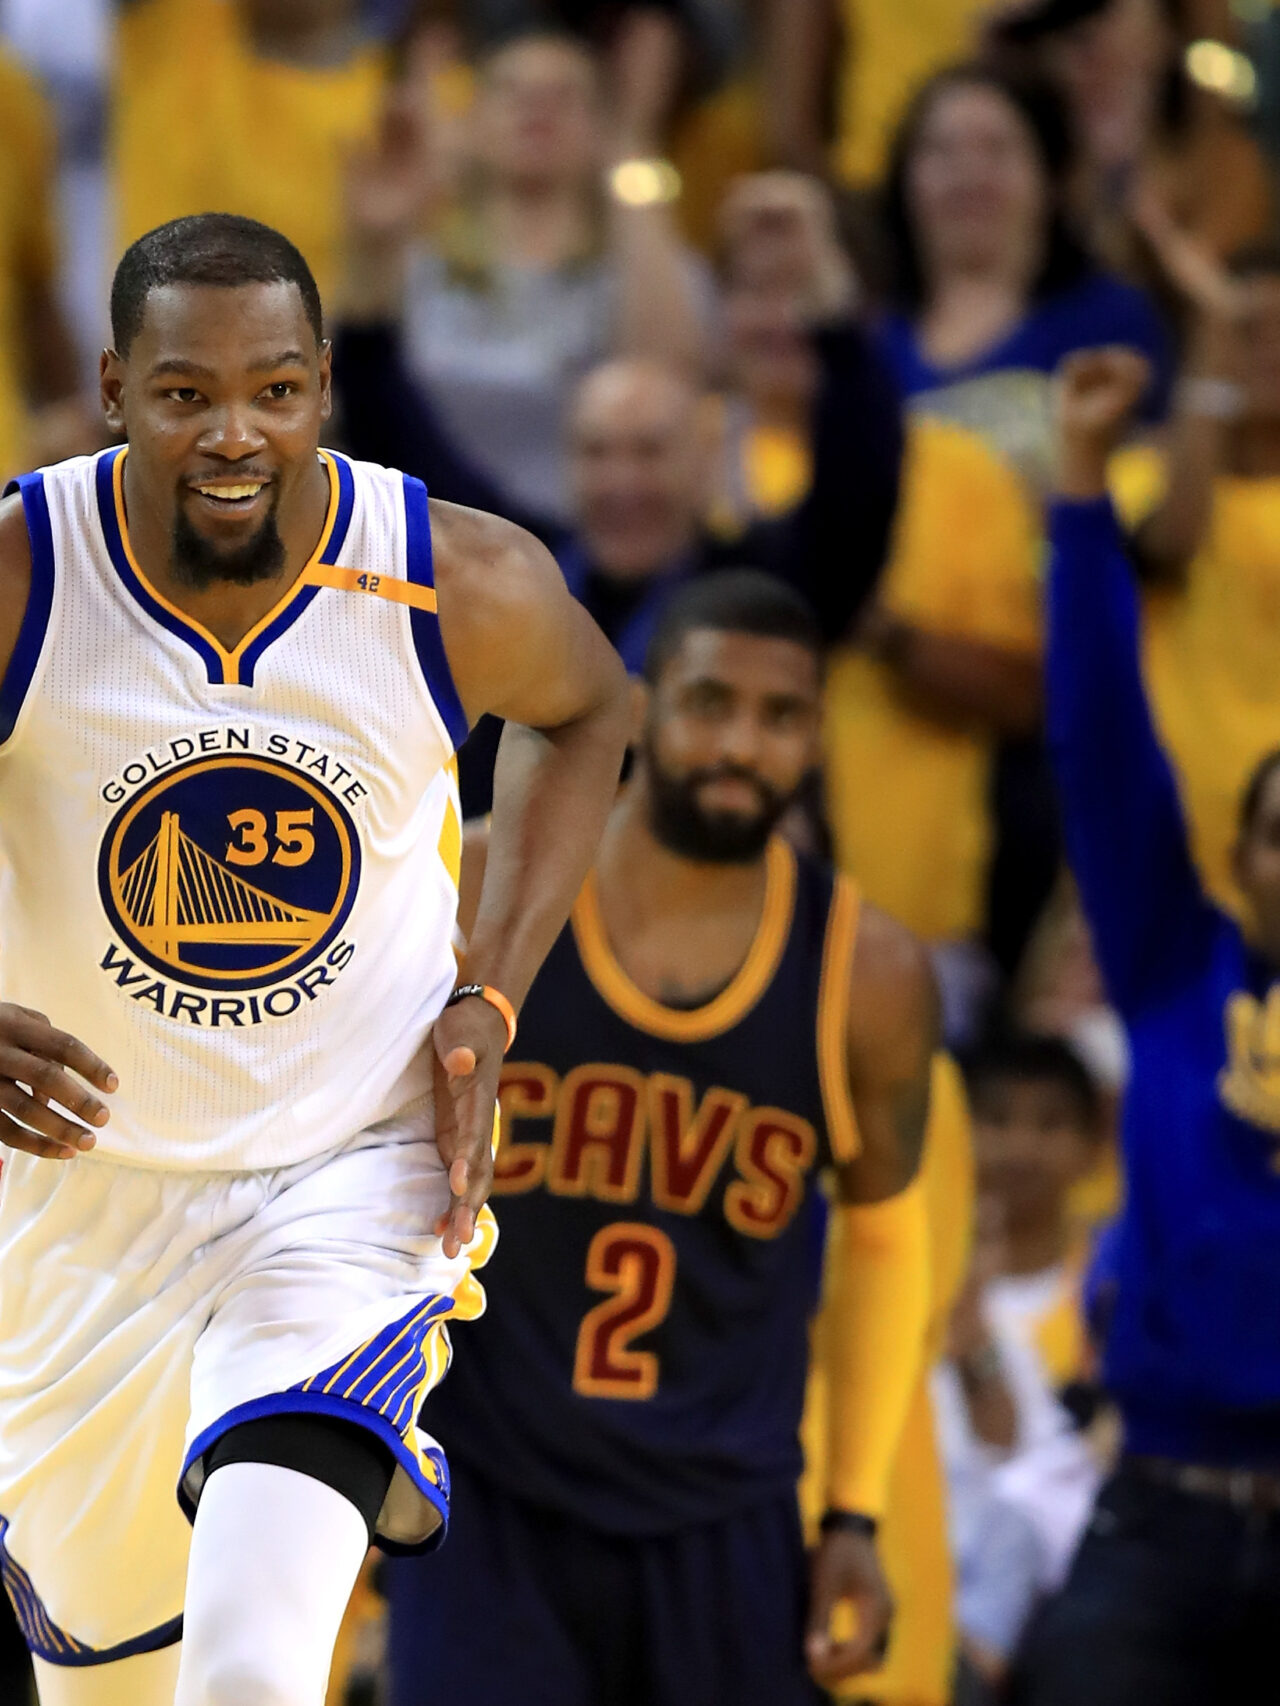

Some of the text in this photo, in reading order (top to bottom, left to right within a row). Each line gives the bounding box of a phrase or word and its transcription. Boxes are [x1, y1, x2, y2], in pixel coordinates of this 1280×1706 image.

[357, 573, 380, 593] 42
[102, 728, 368, 806] GOLDEN STATE
[225, 807, 316, 868] 35
[99, 938, 356, 1027] WARRIORS
[491, 1061, 818, 1240] CAVS
[573, 1221, 677, 1400] 2
